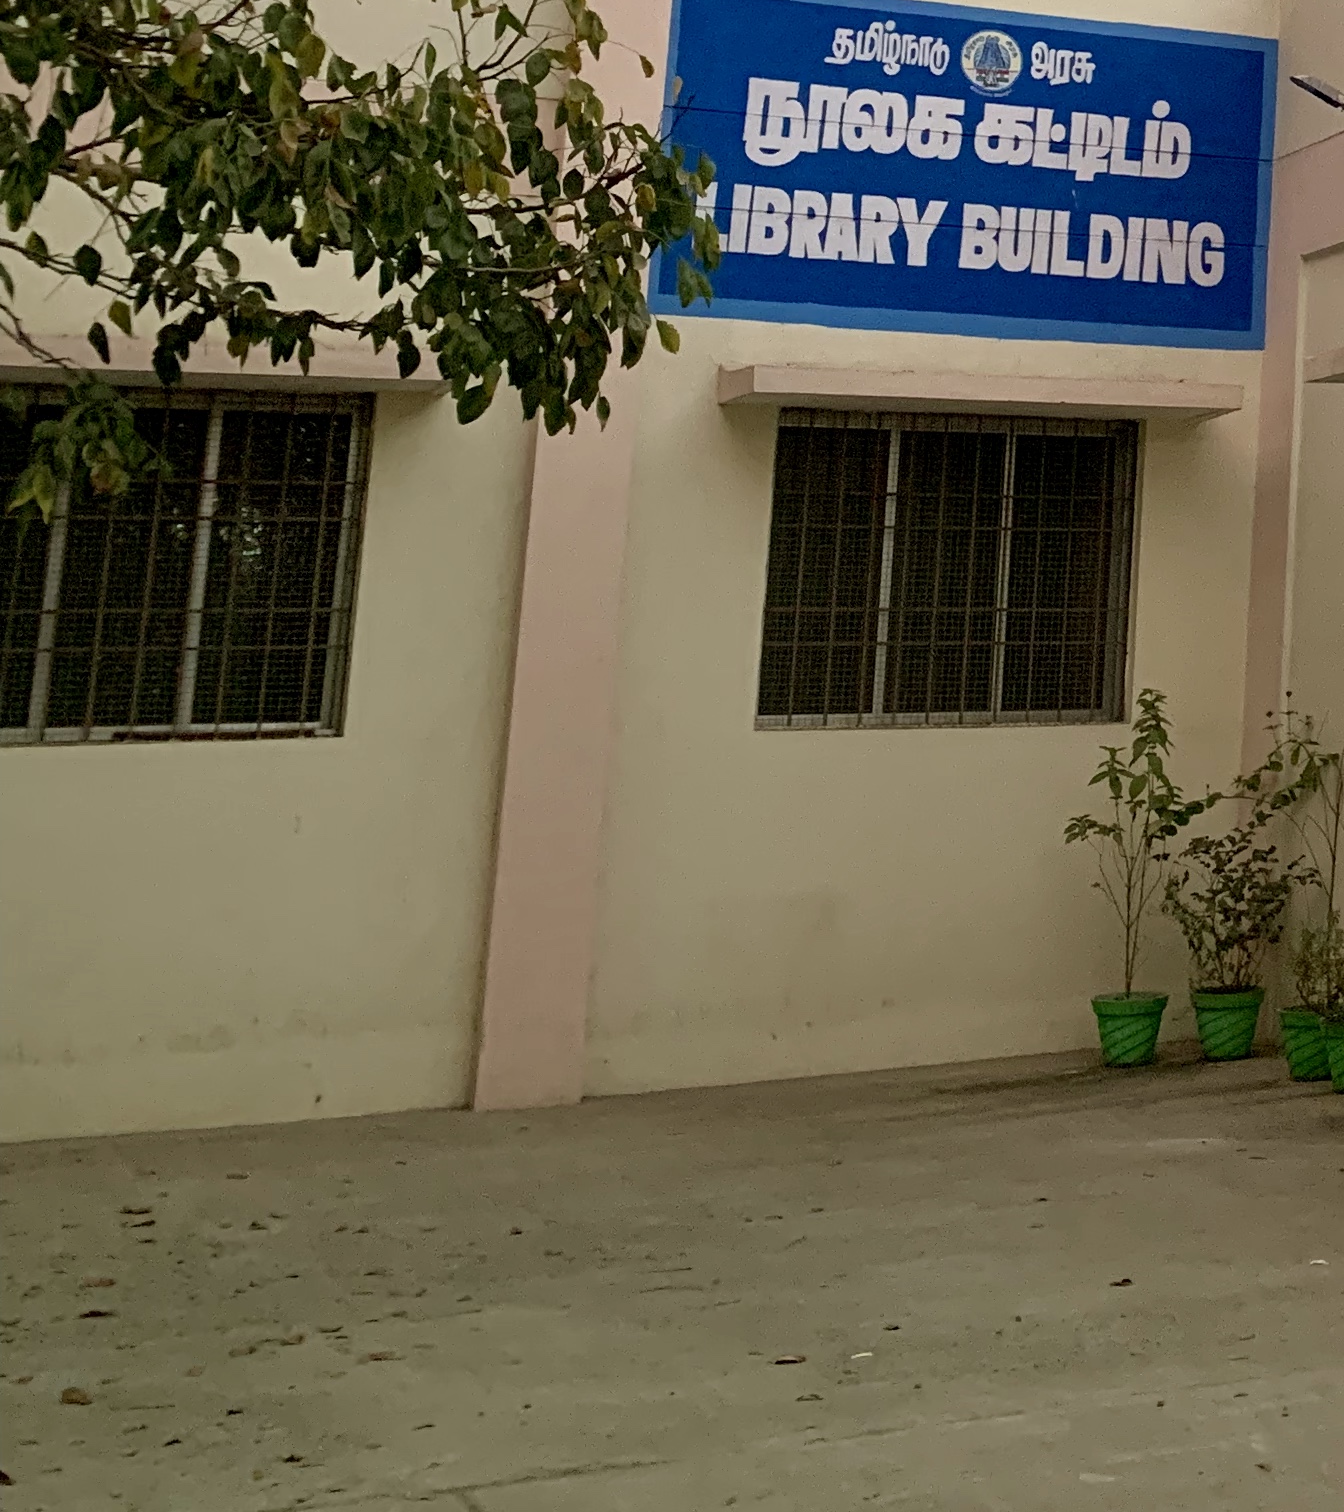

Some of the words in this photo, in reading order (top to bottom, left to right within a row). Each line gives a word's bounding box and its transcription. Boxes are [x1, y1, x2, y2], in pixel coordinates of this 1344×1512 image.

[824, 19, 950, 76] தமிழ்நாடு
[1031, 41, 1096, 86] அரசு
[743, 77, 965, 167] நூலக
[974, 99, 1191, 182] கட்டிடம்
[958, 202, 1225, 287] BUILDING
